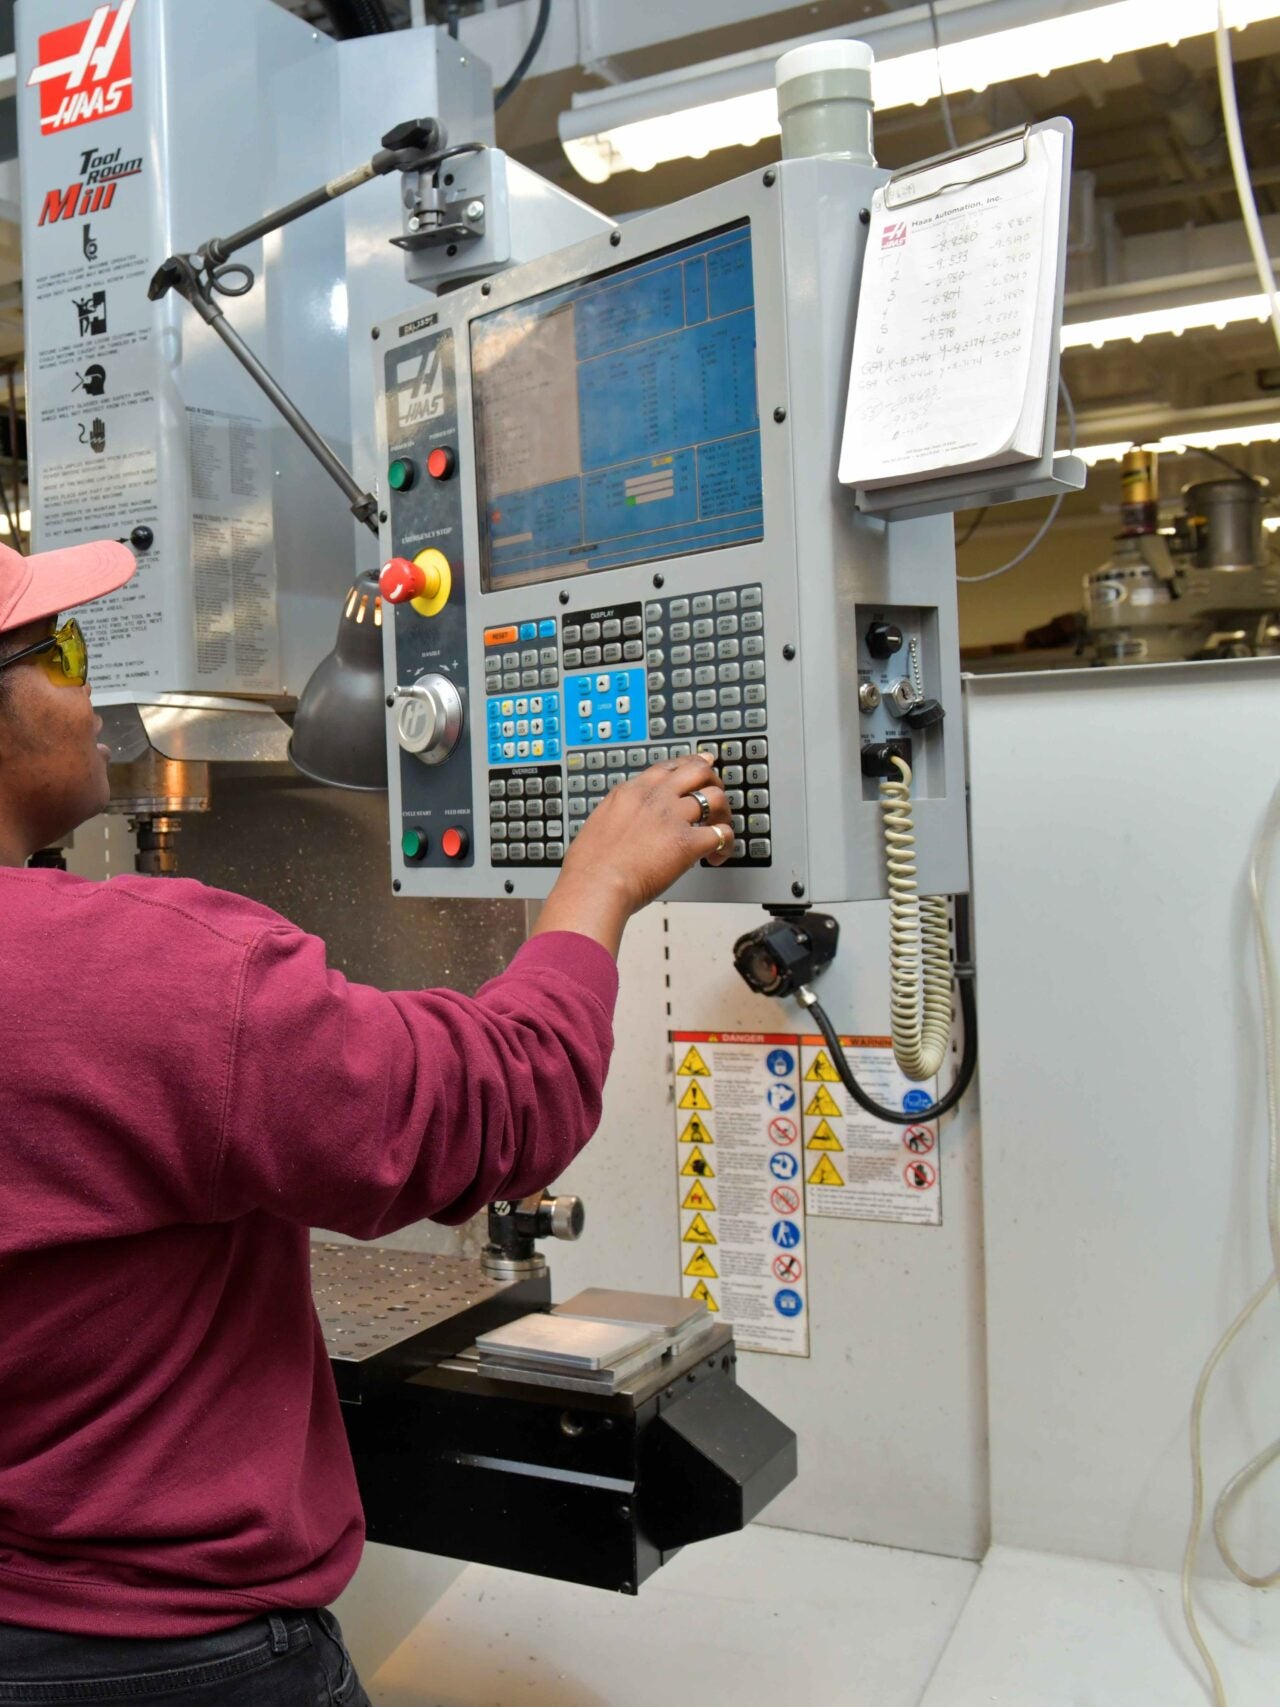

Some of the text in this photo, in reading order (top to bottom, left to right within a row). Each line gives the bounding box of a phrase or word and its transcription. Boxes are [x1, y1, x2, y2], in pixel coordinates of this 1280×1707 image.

[41, 77, 132, 127] HAAS
[80, 147, 121, 175] Tool
[38, 182, 117, 227] Mill
[912, 195, 1002, 228] Haas Automation, Inc.
[399, 393, 444, 423] HAAS
[436, 527, 453, 538] STOP
[590, 610, 614, 620] DISPLAY
[543, 652, 551, 660] F4
[511, 767, 538, 775] OVERRIDES
[722, 1033, 764, 1043] DANGER
[851, 1038, 892, 1048] WARNIN
